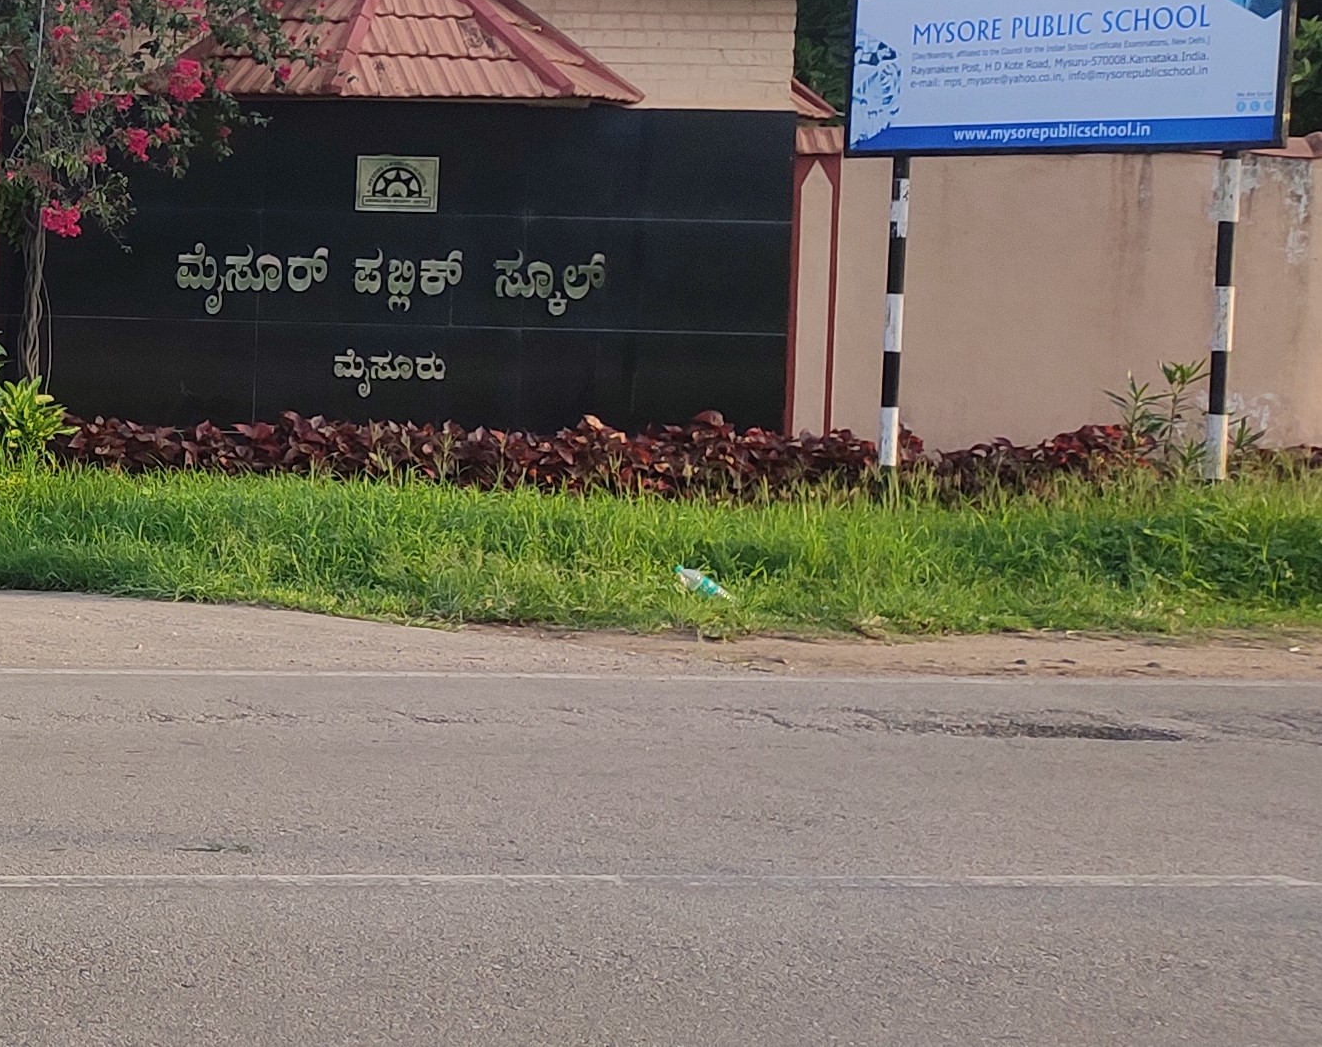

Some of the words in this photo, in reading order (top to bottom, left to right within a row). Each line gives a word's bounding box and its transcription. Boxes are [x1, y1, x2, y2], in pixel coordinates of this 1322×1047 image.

[913, 18, 1002, 45] MYSORE
[1011, 12, 1093, 39] PUBLIC
[1101, 4, 1210, 33] SCHOOL
[985, 61, 992, 71] H
[994, 61, 1001, 71] D
[1004, 60, 1023, 70] Kote
[953, 121, 1151, 142] www.mysorepublicschool.in
[176, 242, 329, 315] ಮೈಸೂರ್
[352, 248, 463, 312] ಪಬ್ಲಿಕ್
[495, 250, 606, 316] ಸ್ಕೂಲ್
[333, 348, 446, 398] ಮೈಸೂರು
